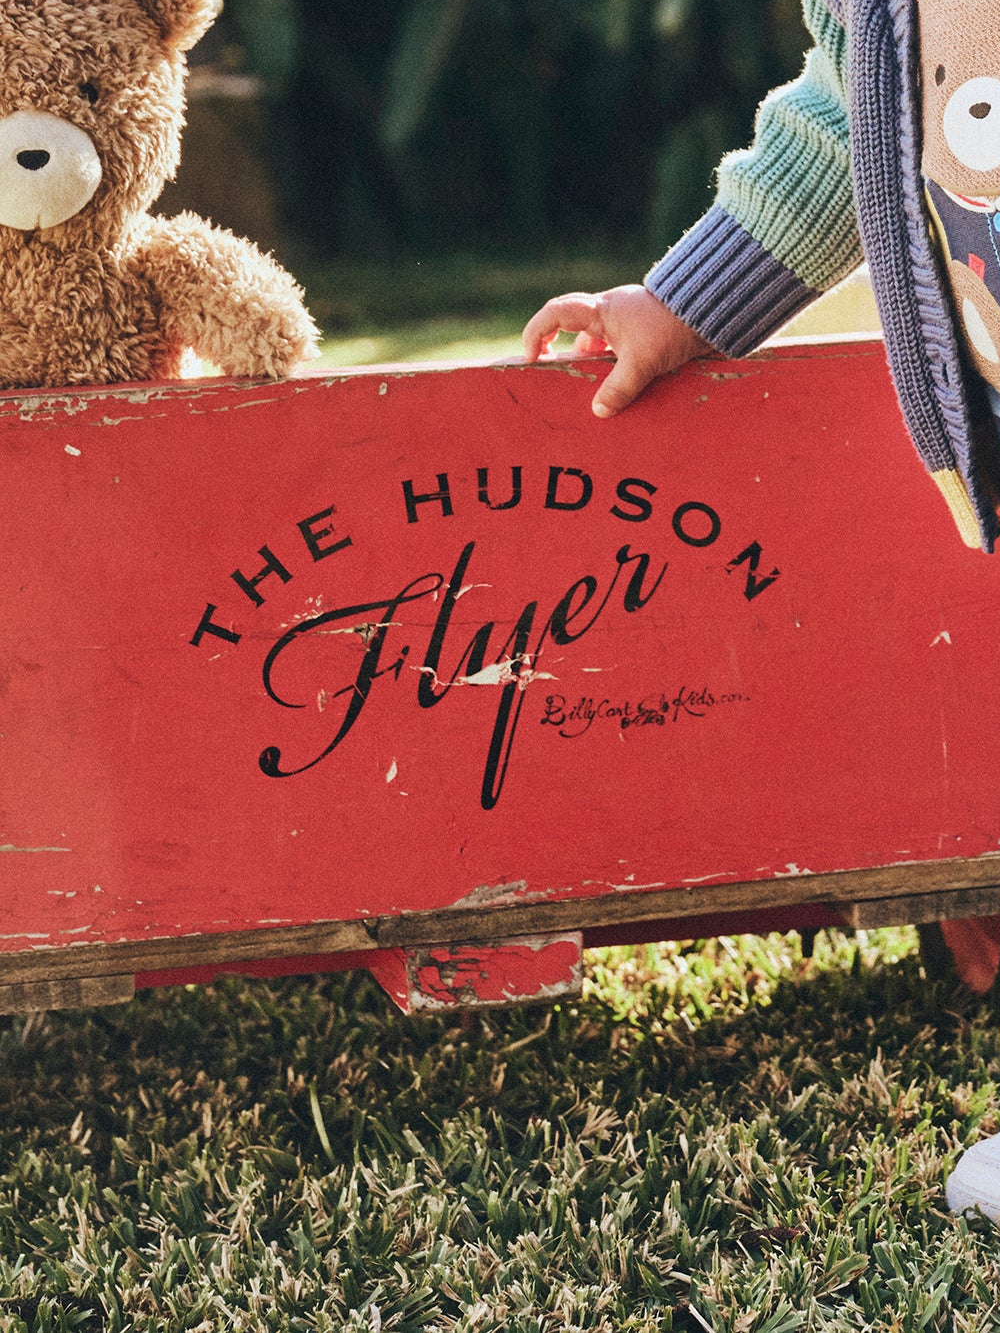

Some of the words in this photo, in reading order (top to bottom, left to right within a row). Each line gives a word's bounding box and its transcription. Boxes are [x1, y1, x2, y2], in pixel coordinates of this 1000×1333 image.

[189, 505, 353, 649] THE
[401, 466, 781, 601] HUDSON
[258, 541, 668, 810] Flyer
